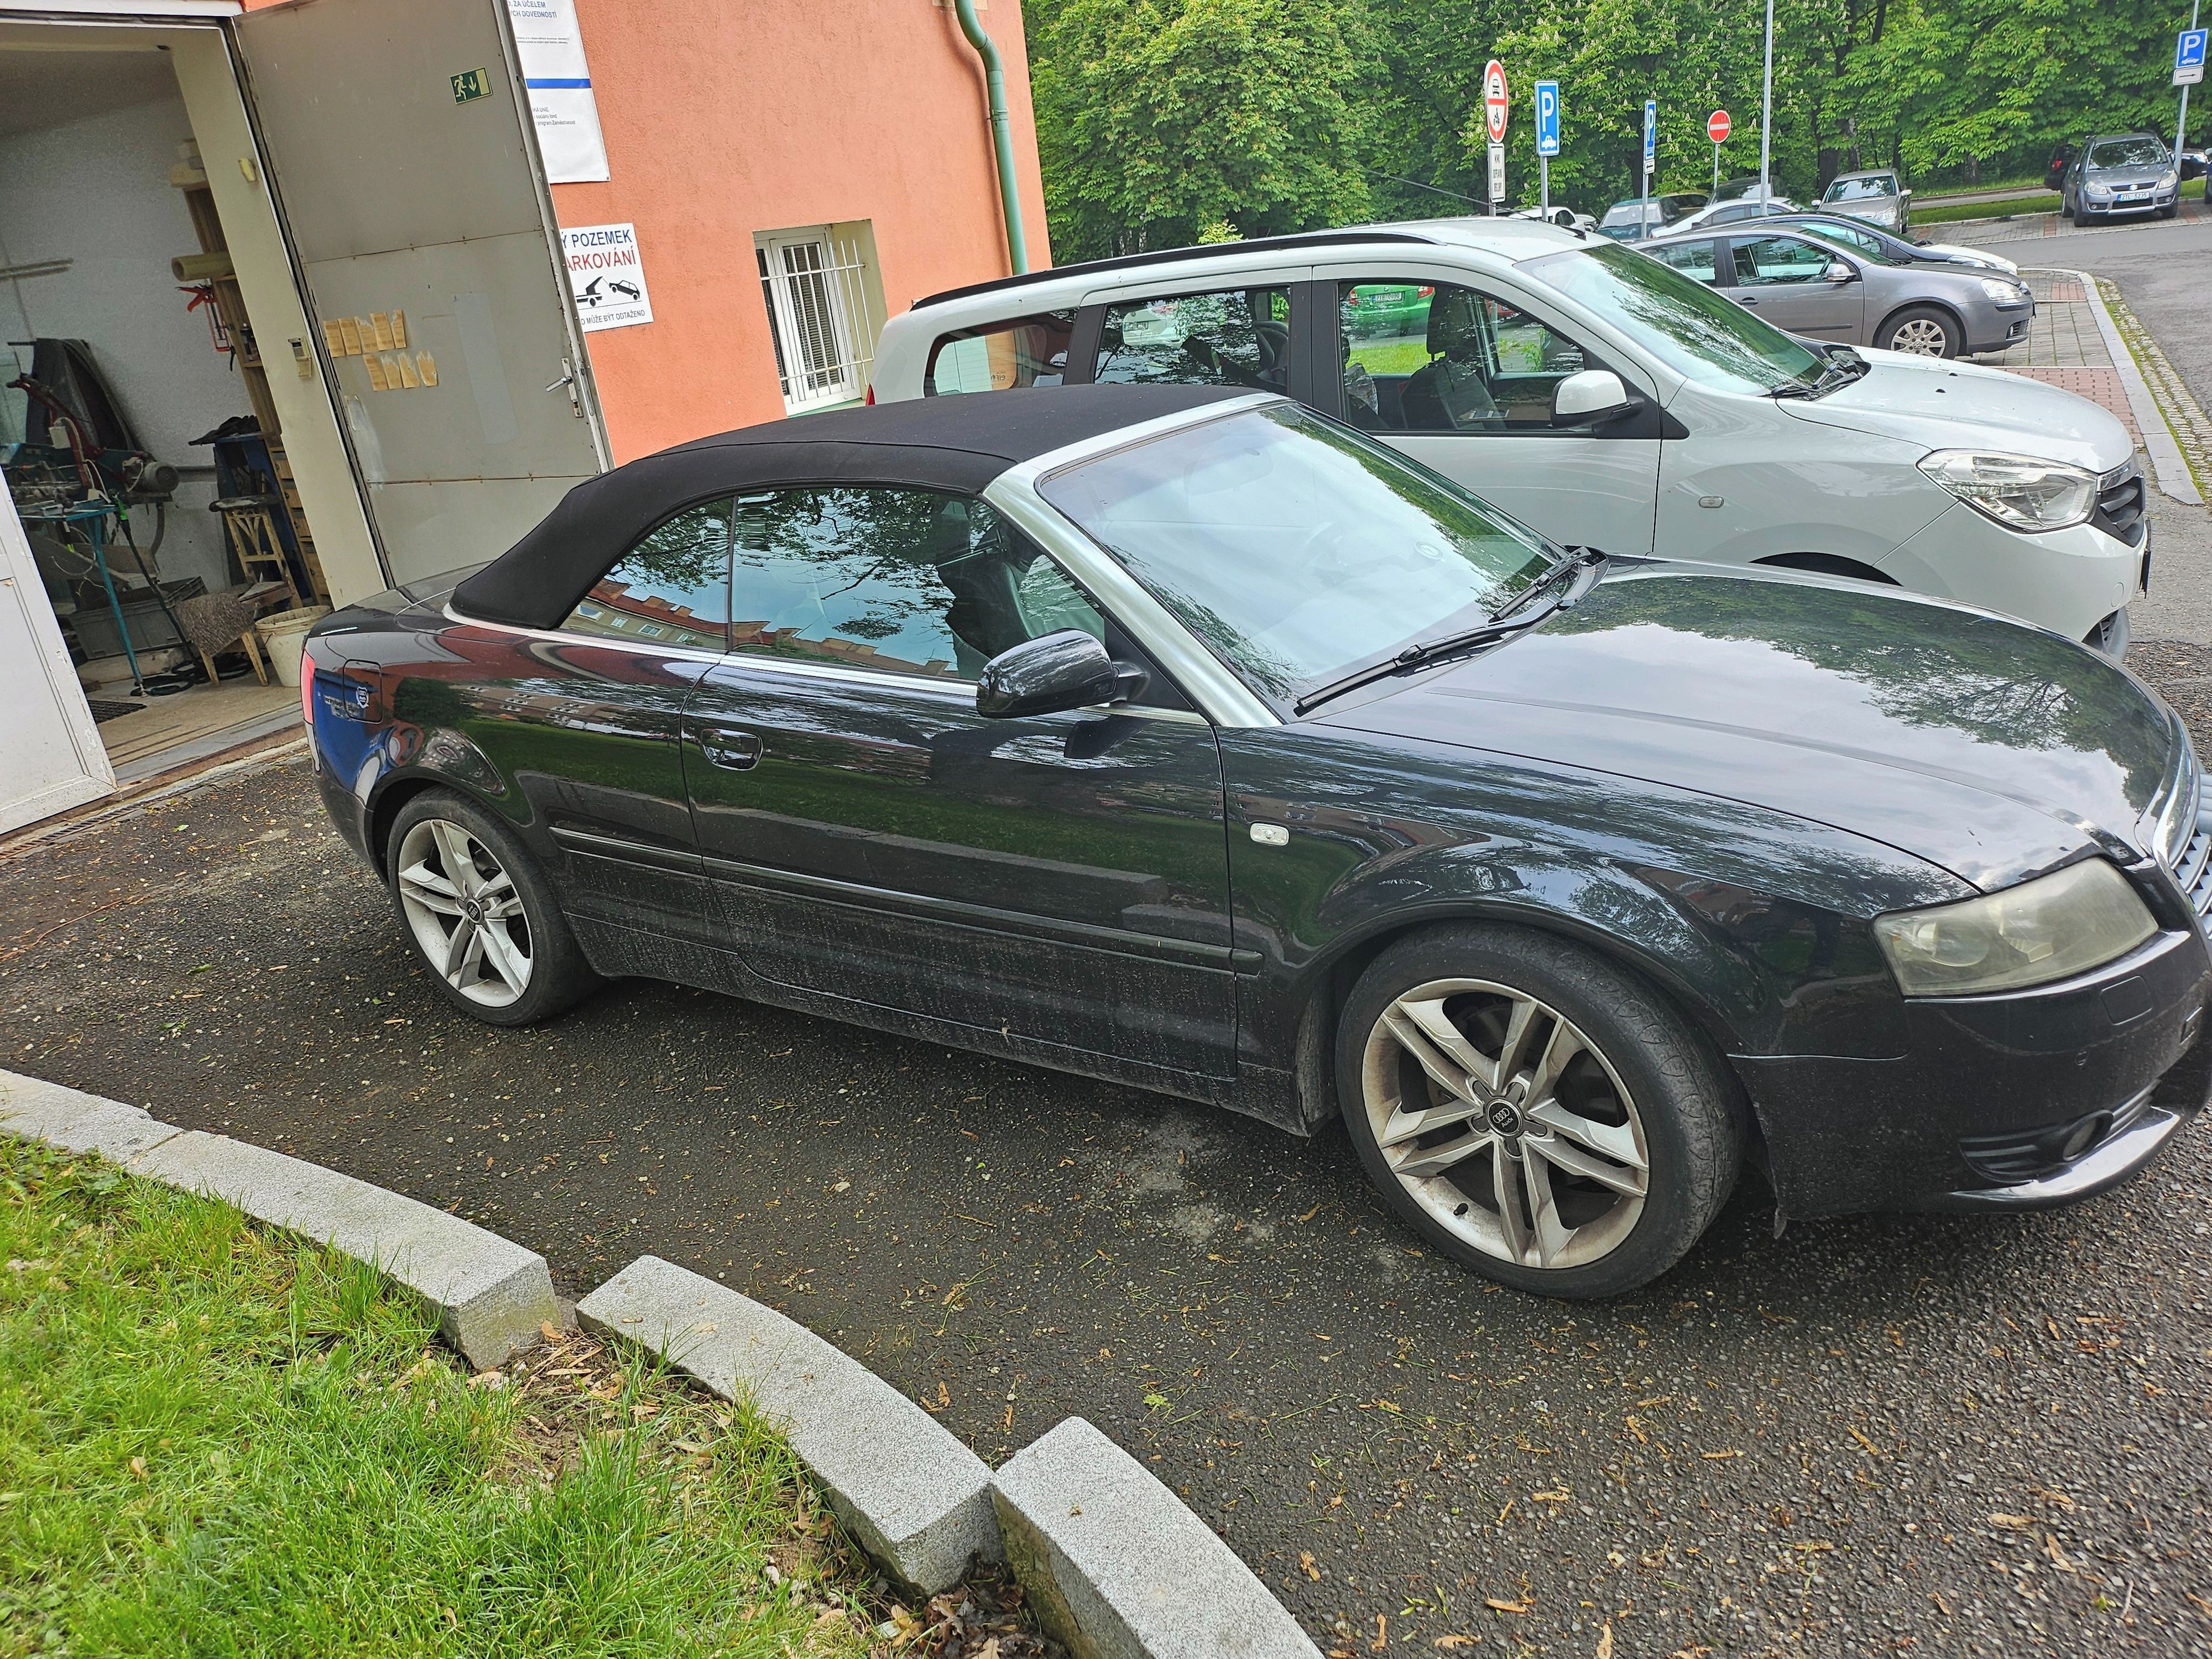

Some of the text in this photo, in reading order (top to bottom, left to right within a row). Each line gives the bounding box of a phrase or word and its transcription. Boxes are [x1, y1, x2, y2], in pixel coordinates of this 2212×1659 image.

[2183, 34, 2201, 57] P
[1541, 91, 1554, 132] P
[1648, 108, 1654, 142] P
[571, 229, 632, 248] POZEMEK
[586, 314, 603, 324] MŮŽE
[603, 312, 615, 322] BÝT
[615, 310, 645, 320] ODTAŽENO
[1501, 1117, 1514, 1128] Audi
